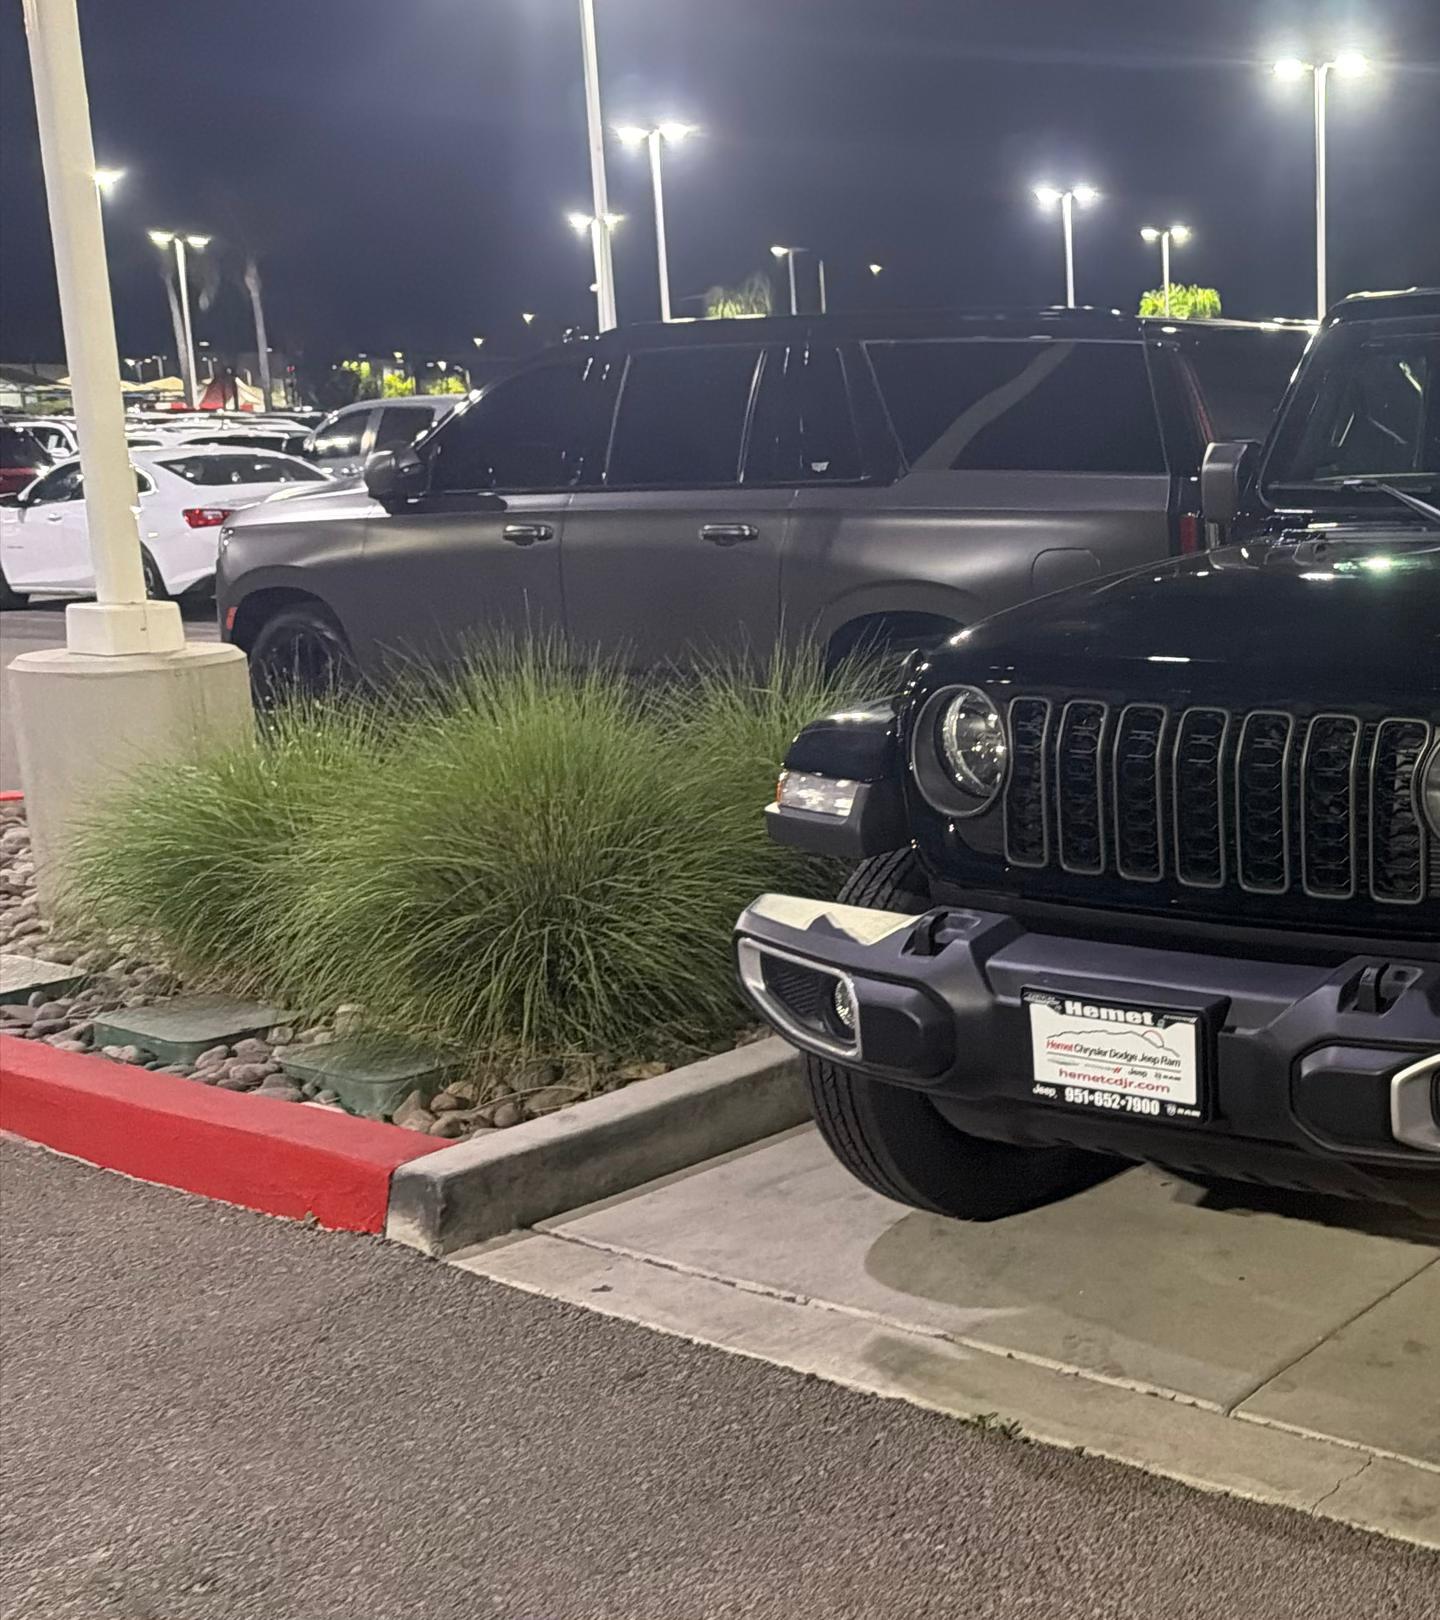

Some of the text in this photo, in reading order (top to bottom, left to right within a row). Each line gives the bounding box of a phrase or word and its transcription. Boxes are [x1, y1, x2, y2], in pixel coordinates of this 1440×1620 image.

[1064, 1000, 1154, 1026] Hemet
[1046, 1040, 1181, 1068] Hemet Chrysler Dodge Jeep Ram
[1059, 1068, 1170, 1093] hemetcdjr.com
